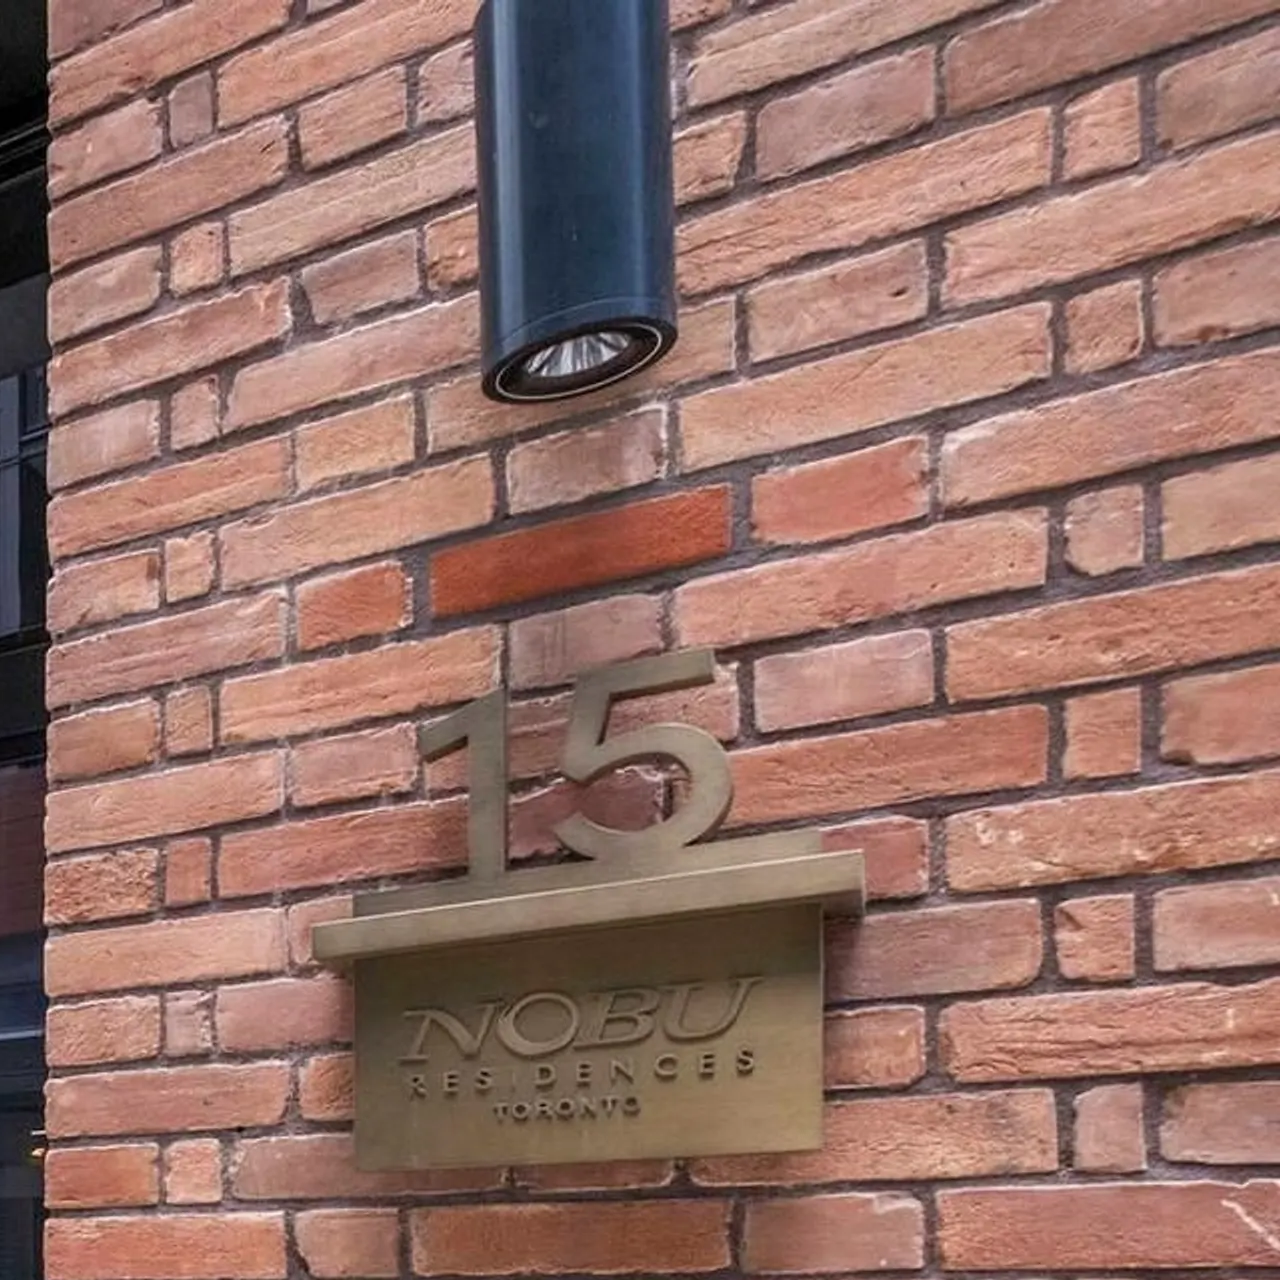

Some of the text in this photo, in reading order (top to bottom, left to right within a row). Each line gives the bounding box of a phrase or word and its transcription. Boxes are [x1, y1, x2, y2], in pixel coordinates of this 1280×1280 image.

[417, 649, 734, 883] 15
[398, 974, 764, 1061] NOBU
[409, 1049, 756, 1098] RESIDENCES
[493, 1096, 640, 1124] TORONTO
